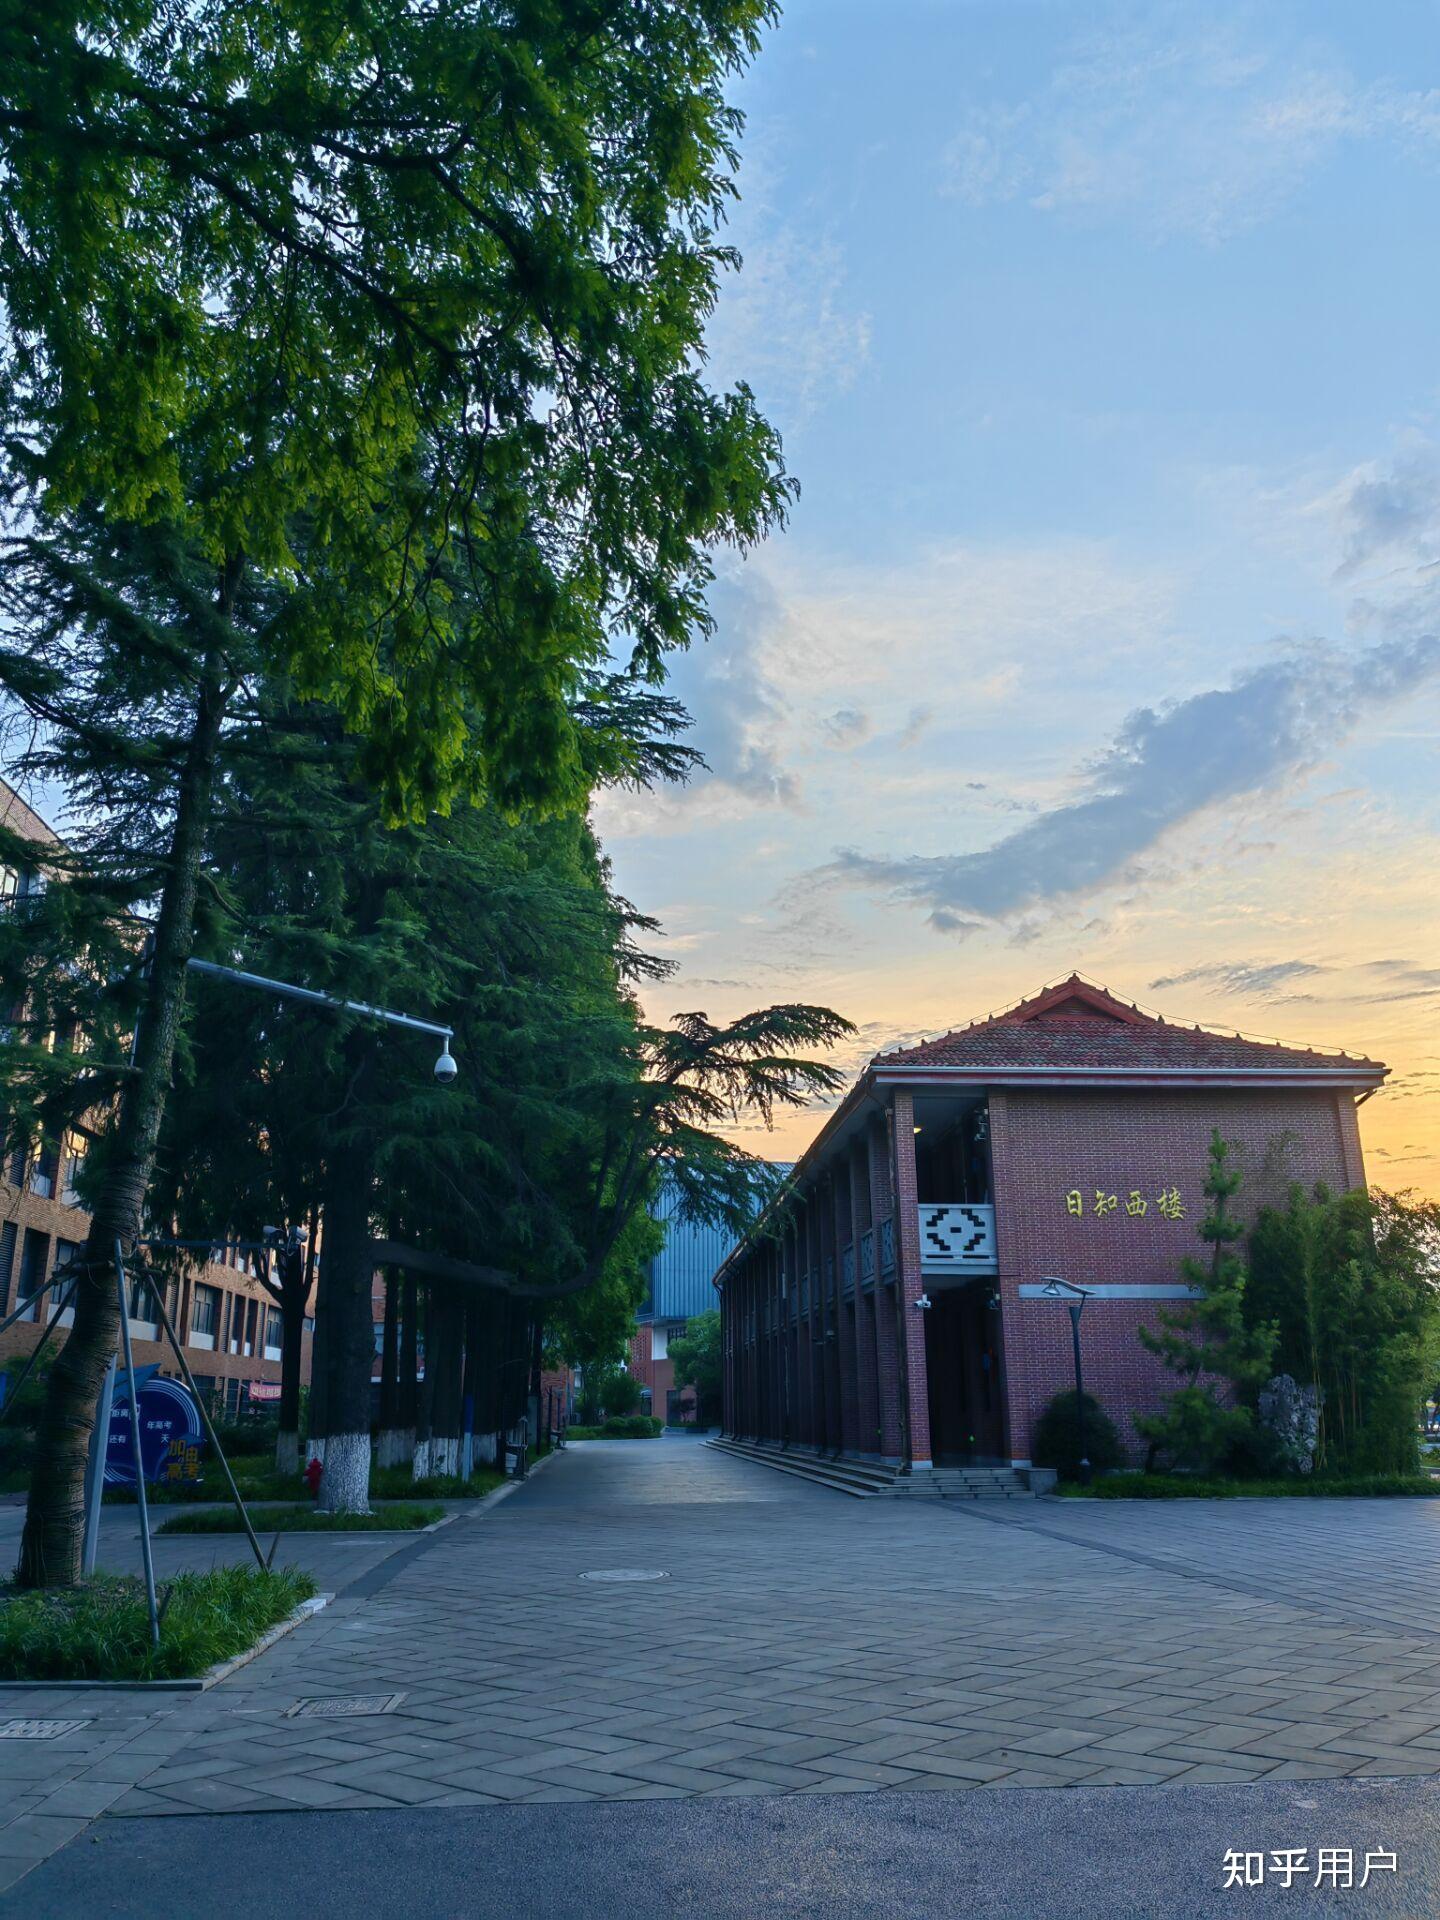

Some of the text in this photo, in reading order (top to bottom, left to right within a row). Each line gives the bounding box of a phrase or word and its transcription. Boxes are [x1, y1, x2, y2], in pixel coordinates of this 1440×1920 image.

[1066, 1187, 1187, 1219] 日知西楼
[160, 1433, 170, 1444] 天
